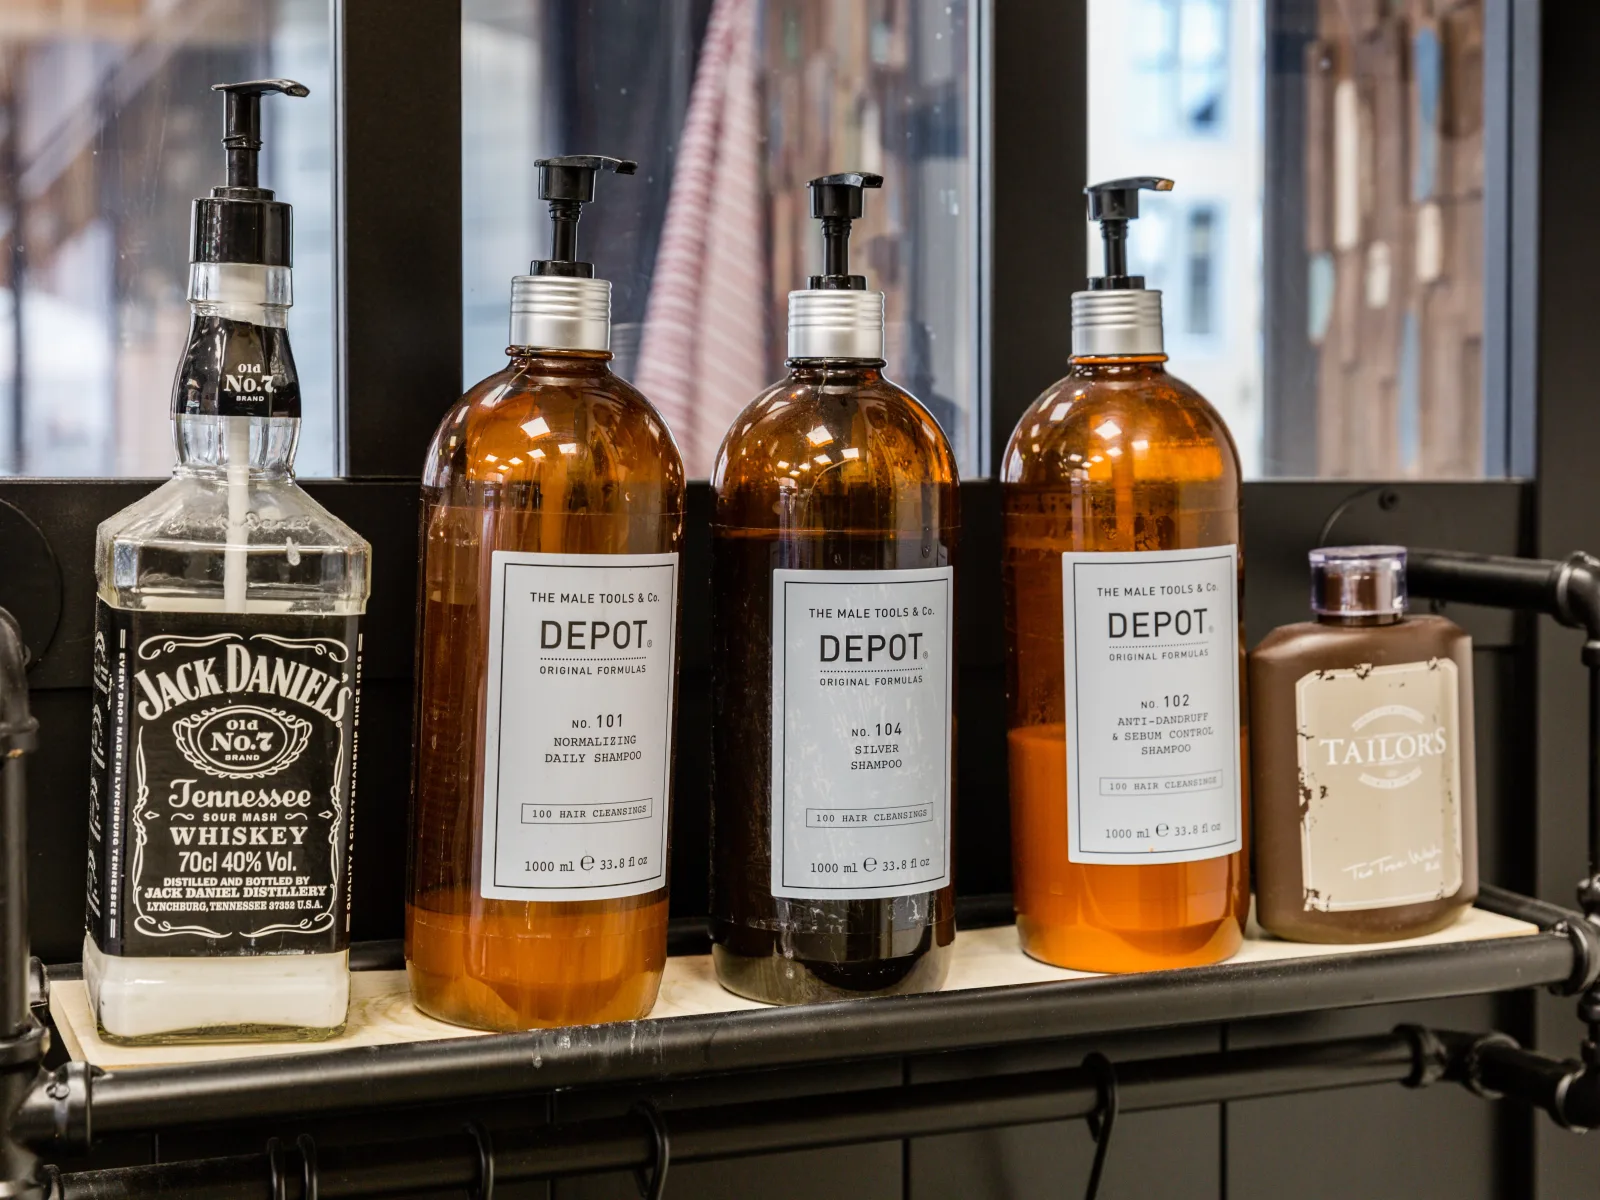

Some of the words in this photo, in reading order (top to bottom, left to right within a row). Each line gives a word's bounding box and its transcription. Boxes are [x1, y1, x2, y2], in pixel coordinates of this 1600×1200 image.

[237, 363, 261, 374] Old
[1097, 587, 1120, 597] THE
[1124, 586, 1156, 597] MALE
[1160, 584, 1194, 596] TOOLS
[1196, 583, 1203, 593] &
[529, 592, 556, 603] THE
[560, 593, 595, 604] MALE
[599, 593, 634, 604] TOOLS
[637, 594, 645, 603] &
[647, 592, 660, 603] Co.
[809, 608, 833, 619] THE
[837, 608, 871, 619] MALE
[875, 607, 909, 618] TOOLS
[912, 606, 919, 617] &
[921, 606, 935, 616] Co.
[1109, 653, 1158, 662] ORIGINAL
[1162, 648, 1209, 660] FORMULAS
[539, 665, 593, 676] ORIGINAL
[597, 664, 647, 675] FORMULAS
[819, 678, 870, 687] ORIGINAL
[874, 675, 923, 686] FORMULAS
[134, 656, 224, 721] JACK
[1164, 694, 1190, 708] 102
[226, 719, 259, 731] Old
[571, 719, 591, 729] NO.
[596, 713, 623, 729] 101
[1117, 712, 1209, 726] ANTI-DANDRUFF
[851, 728, 870, 737] NO.
[875, 722, 902, 736] 104
[1112, 732, 1119, 741] &
[1124, 731, 1162, 741] SEBUM
[1169, 726, 1214, 739] CONTROL
[115, 726, 123, 760] MADE
[210, 731, 274, 752] No.7
[553, 735, 637, 747] NORMALIZING
[1319, 727, 1446, 766] TAILOR'S
[544, 753, 586, 763] DAILY
[594, 750, 642, 763] SHAMPOO
[854, 744, 899, 755] SILVER
[1141, 744, 1192, 755] SHAMPOO
[115, 761, 122, 774] IN
[850, 759, 903, 770] SHAMPOO
[1110, 783, 1128, 791] 100
[1134, 782, 1159, 791] HAIR
[1164, 776, 1217, 789] CLEANSINGS
[168, 778, 311, 808] Tennessee
[112, 775, 121, 846] LYNCHBURG
[203, 812, 237, 823] SOUR
[242, 812, 278, 822] MASH
[532, 809, 552, 818] 100
[559, 810, 586, 818] HAIR
[592, 804, 647, 818] CLEANSINGS
[816, 814, 835, 823] 100
[842, 814, 868, 823] HAIR
[873, 809, 928, 822] CLEANSINGS
[169, 826, 308, 846] WHISKEY
[1105, 828, 1132, 839] 1000
[1136, 828, 1151, 839] ml
[1174, 825, 1199, 837] 33.8
[1211, 822, 1221, 832] oz
[178, 851, 218, 873] 70cl
[221, 850, 262, 873] 40%
[266, 850, 297, 872] Vol.
[524, 861, 555, 872] 1000
[559, 861, 575, 872] ml
[599, 858, 625, 870] 33.8
[627, 857, 636, 867] fl
[637, 856, 648, 866] oz
[810, 862, 839, 873] 1000
[843, 862, 858, 873] ml
[882, 860, 907, 872] 33.8
[910, 858, 918, 869] fl
[919, 858, 930, 867] oz
[109, 848, 119, 916] TENNESSEE
[163, 877, 217, 887] DISTILLED
[219, 877, 243, 886] AND
[245, 876, 291, 886] BOTTLED
[294, 876, 310, 885] BY
[144, 887, 183, 899] JACK
[185, 887, 240, 898] DANIEL
[243, 885, 327, 897] DISTILLERY
[146, 901, 209, 912] LYNCHBURG,
[209, 900, 267, 911] TENNESSEE
[268, 899, 295, 910] 37352
[297, 899, 323, 909] U.S.A.
